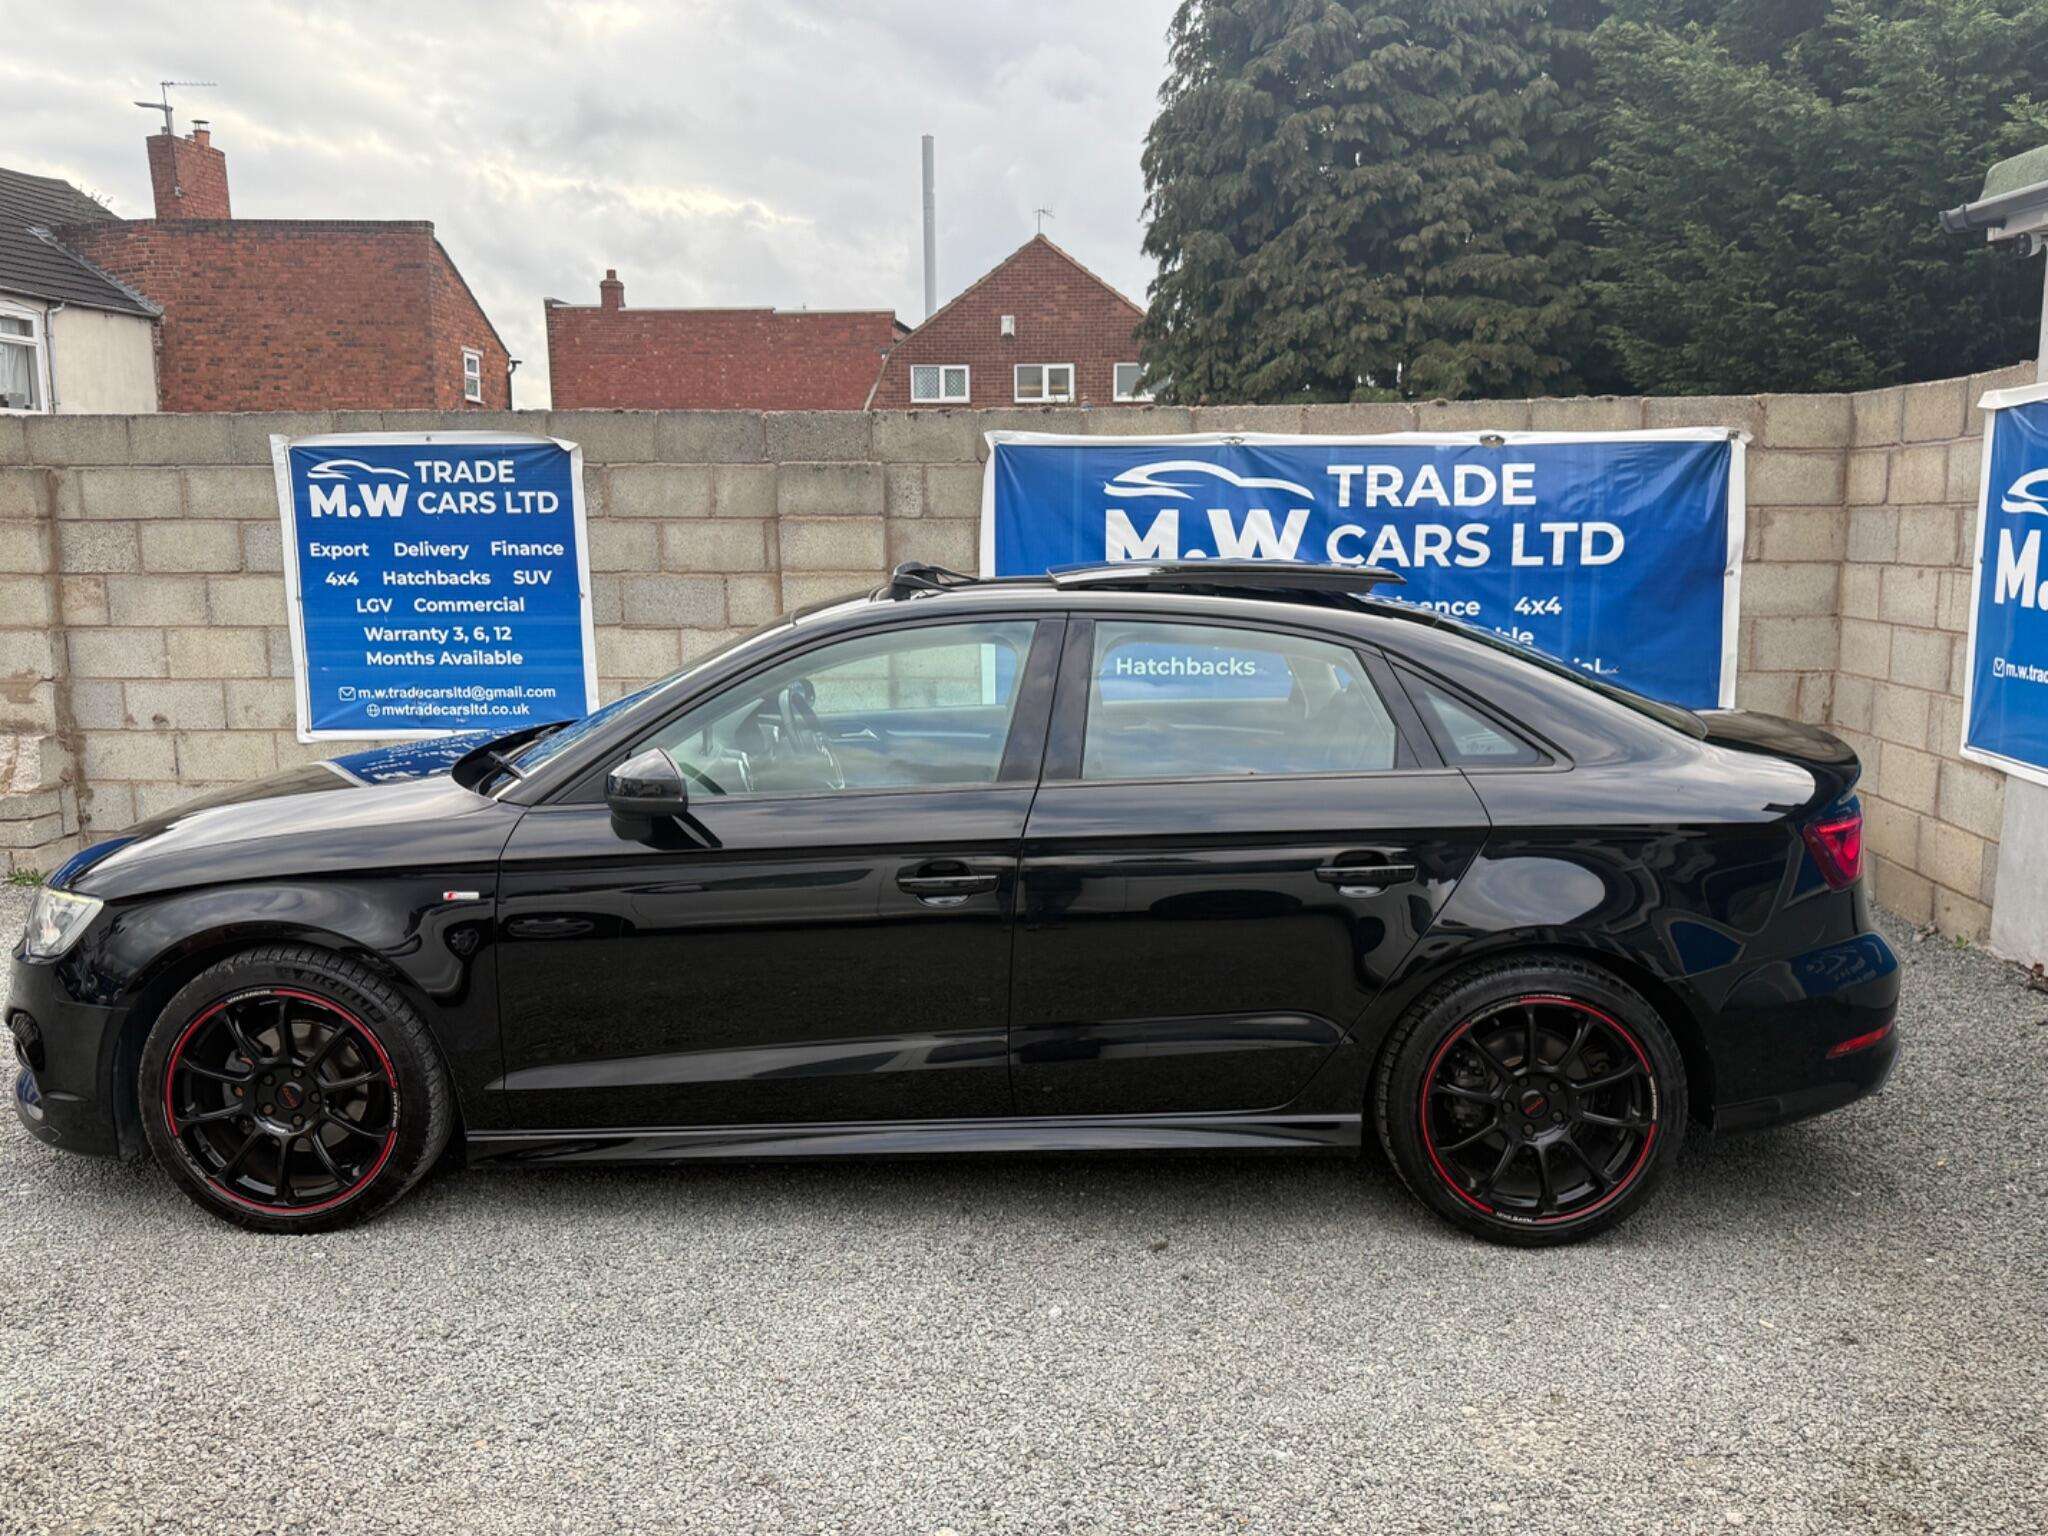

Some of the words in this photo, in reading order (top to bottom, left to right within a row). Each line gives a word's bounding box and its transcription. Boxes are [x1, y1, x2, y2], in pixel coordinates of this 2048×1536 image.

[414, 460, 515, 483] TRADE
[1327, 463, 1536, 506] TRADE
[309, 484, 408, 517] M.W
[418, 491, 496, 514] CARS
[505, 491, 558, 513] LTD
[310, 543, 369, 559] Export
[394, 541, 469, 559] Delivery
[491, 541, 564, 555] Finance
[1326, 523, 1490, 567] CARS
[1512, 522, 1624, 566] LTD
[326, 572, 359, 585] 4x4
[383, 570, 491, 585] Hatchbacks
[514, 570, 552, 584] SUV
[357, 598, 392, 612] LGV
[414, 597, 524, 612] Commercial
[1514, 597, 1562, 614] 4x4
[364, 627, 449, 644] Warranty
[453, 627, 468, 643] 3,
[473, 627, 489, 643] 6,
[494, 627, 512, 640] 12
[367, 651, 435, 665] Months
[440, 651, 523, 664] Available
[1117, 657, 1257, 675] Hatchbacks
[359, 686, 555, 701] m.w.tradecarsltd@gmail.com
[383, 703, 529, 715] mwtradecarsltd.co.uk
